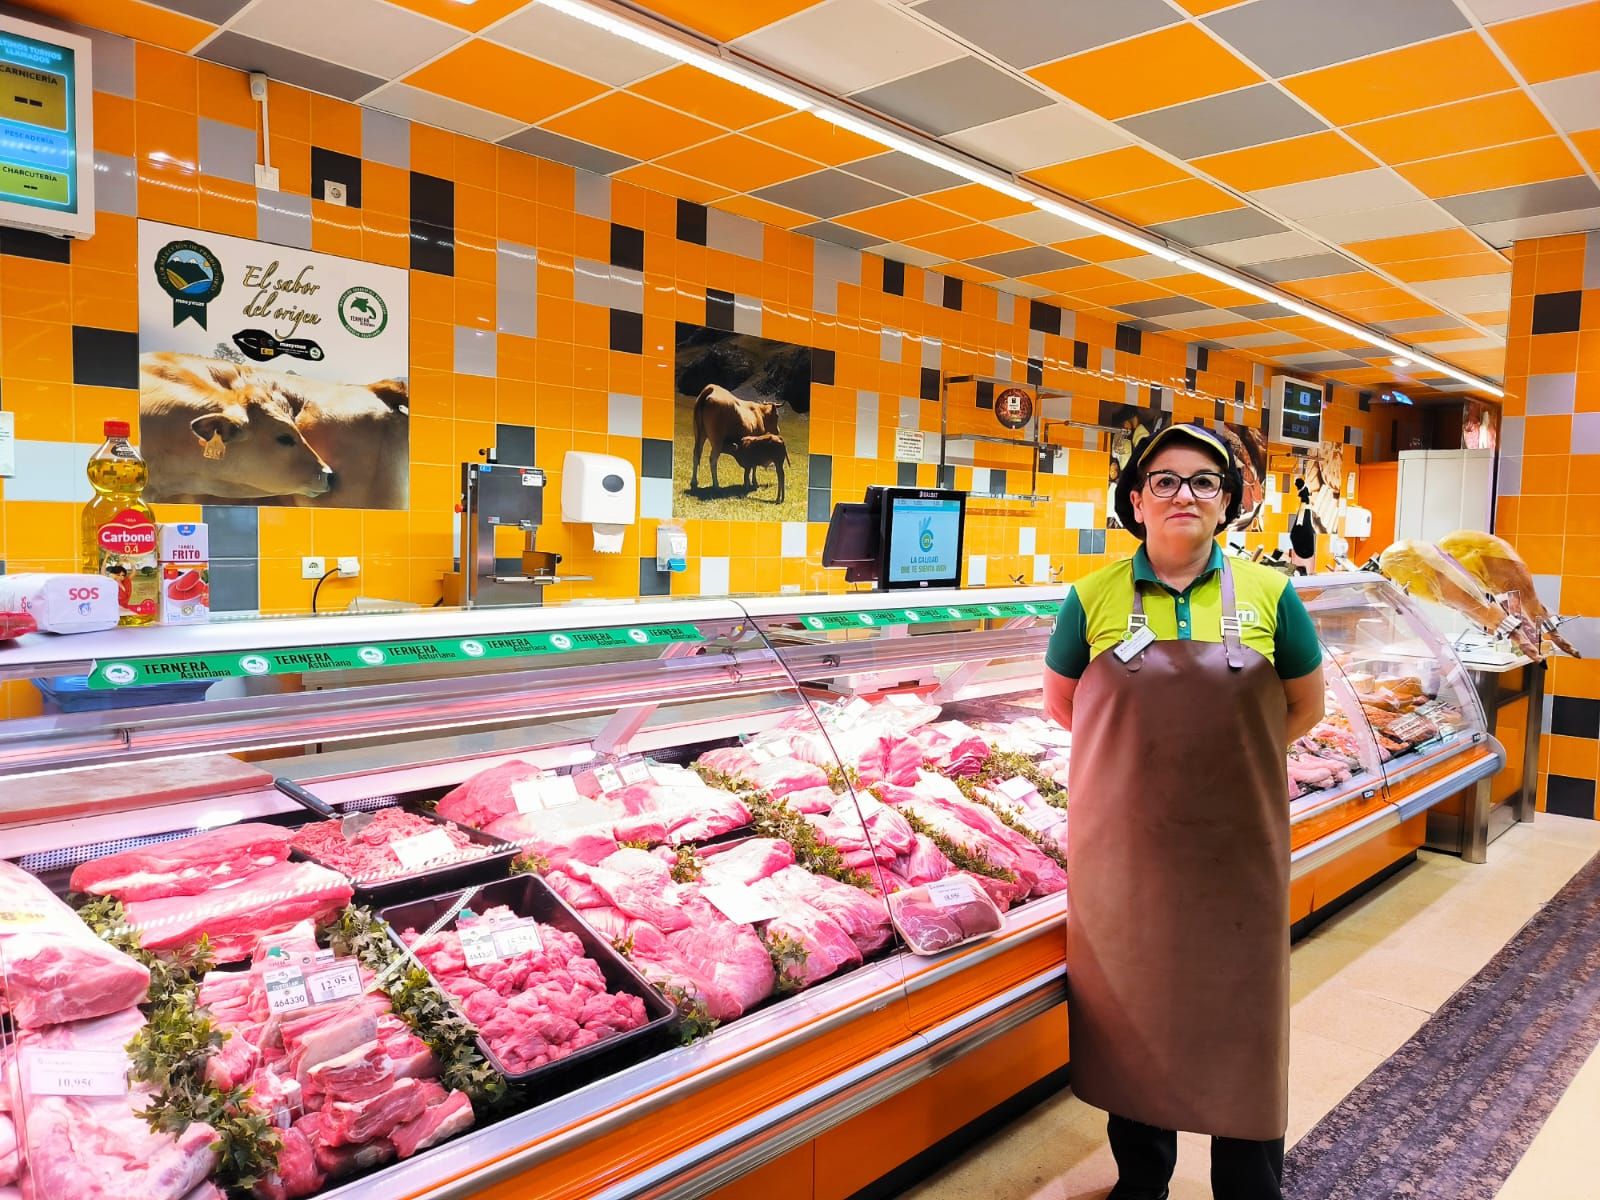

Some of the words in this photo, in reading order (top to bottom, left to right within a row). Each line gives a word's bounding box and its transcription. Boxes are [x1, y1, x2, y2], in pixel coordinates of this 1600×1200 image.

[242, 260, 280, 290] El
[273, 265, 320, 296] sabor
[242, 289, 279, 318] del
[273, 305, 322, 340] origen
[172, 549, 201, 560] FRITO
[68, 587, 99, 601] SOS
[571, 632, 613, 642] TERNERA
[649, 627, 683, 638] TERNERA
[485, 638, 531, 649] TERNERA
[387, 644, 438, 656] TERNERA
[417, 650, 456, 660] Asturiana
[273, 652, 332, 665] TERNERA
[307, 659, 352, 669] Asturiana
[143, 661, 209, 675] TERNERA
[180, 668, 231, 680] Asturiana
[273, 994, 306, 1009] 464330
